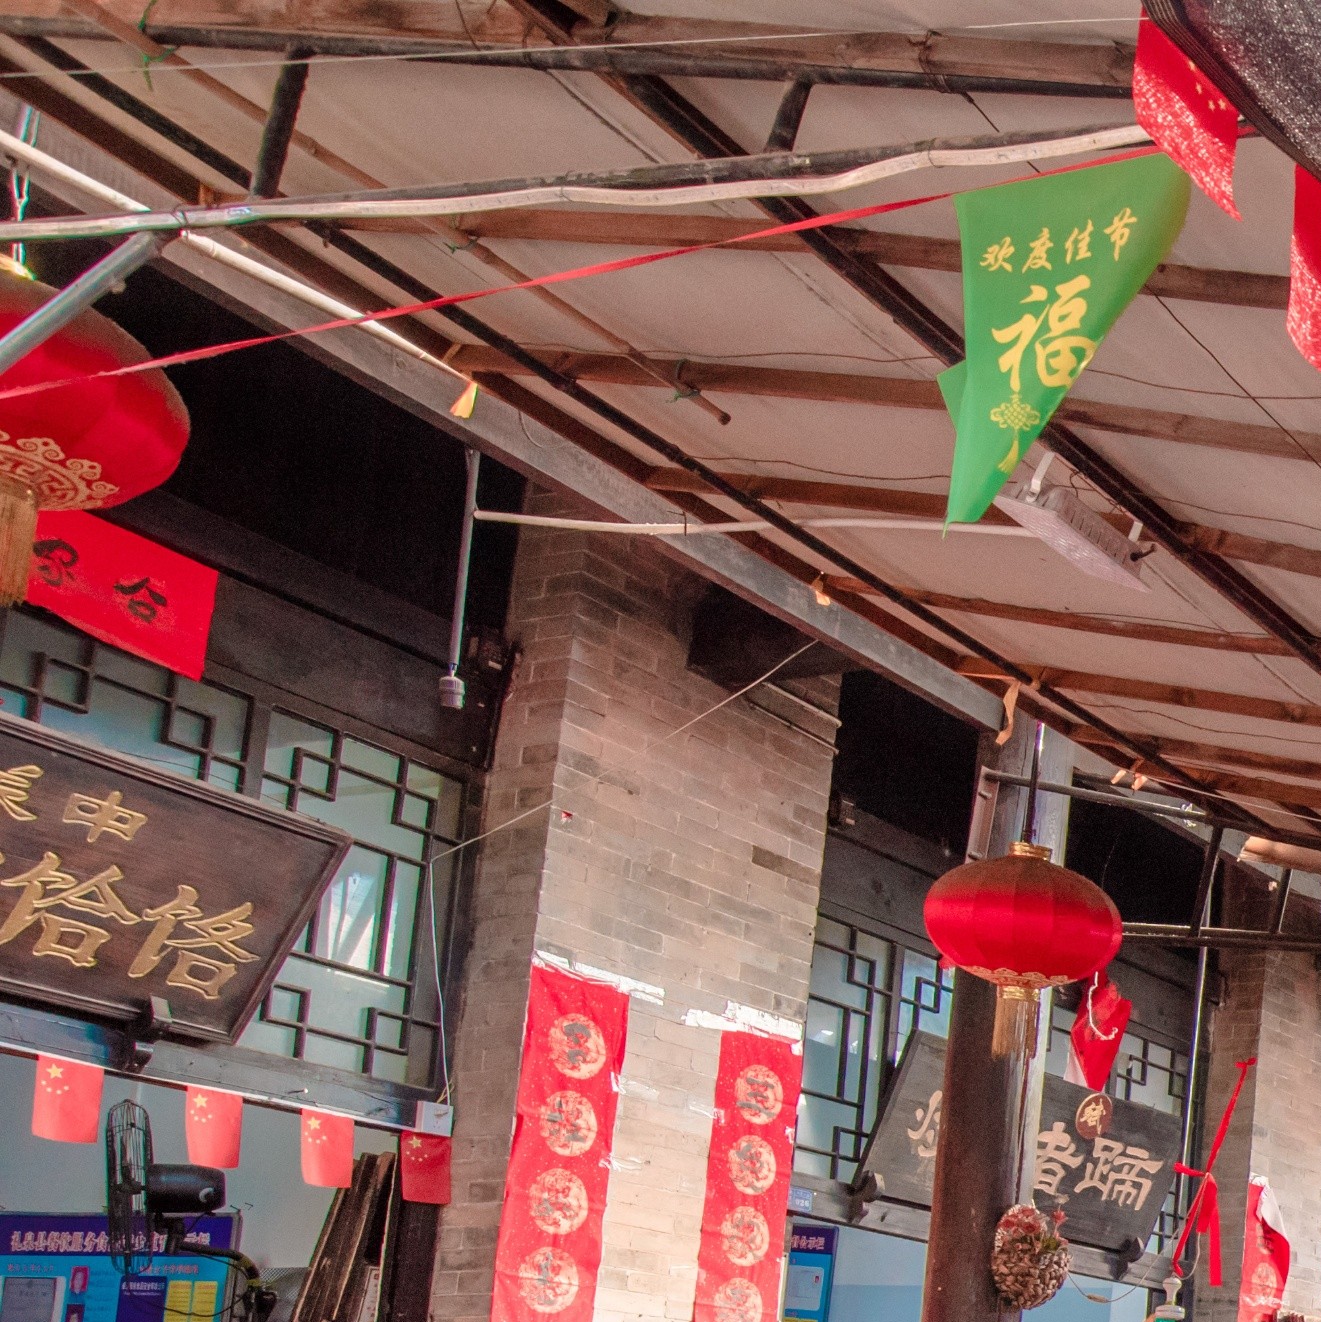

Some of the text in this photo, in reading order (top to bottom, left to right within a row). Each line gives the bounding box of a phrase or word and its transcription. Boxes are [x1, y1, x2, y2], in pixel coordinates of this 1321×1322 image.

[978, 206, 1138, 274] 欢度佳节
[991, 275, 1100, 391] 福
